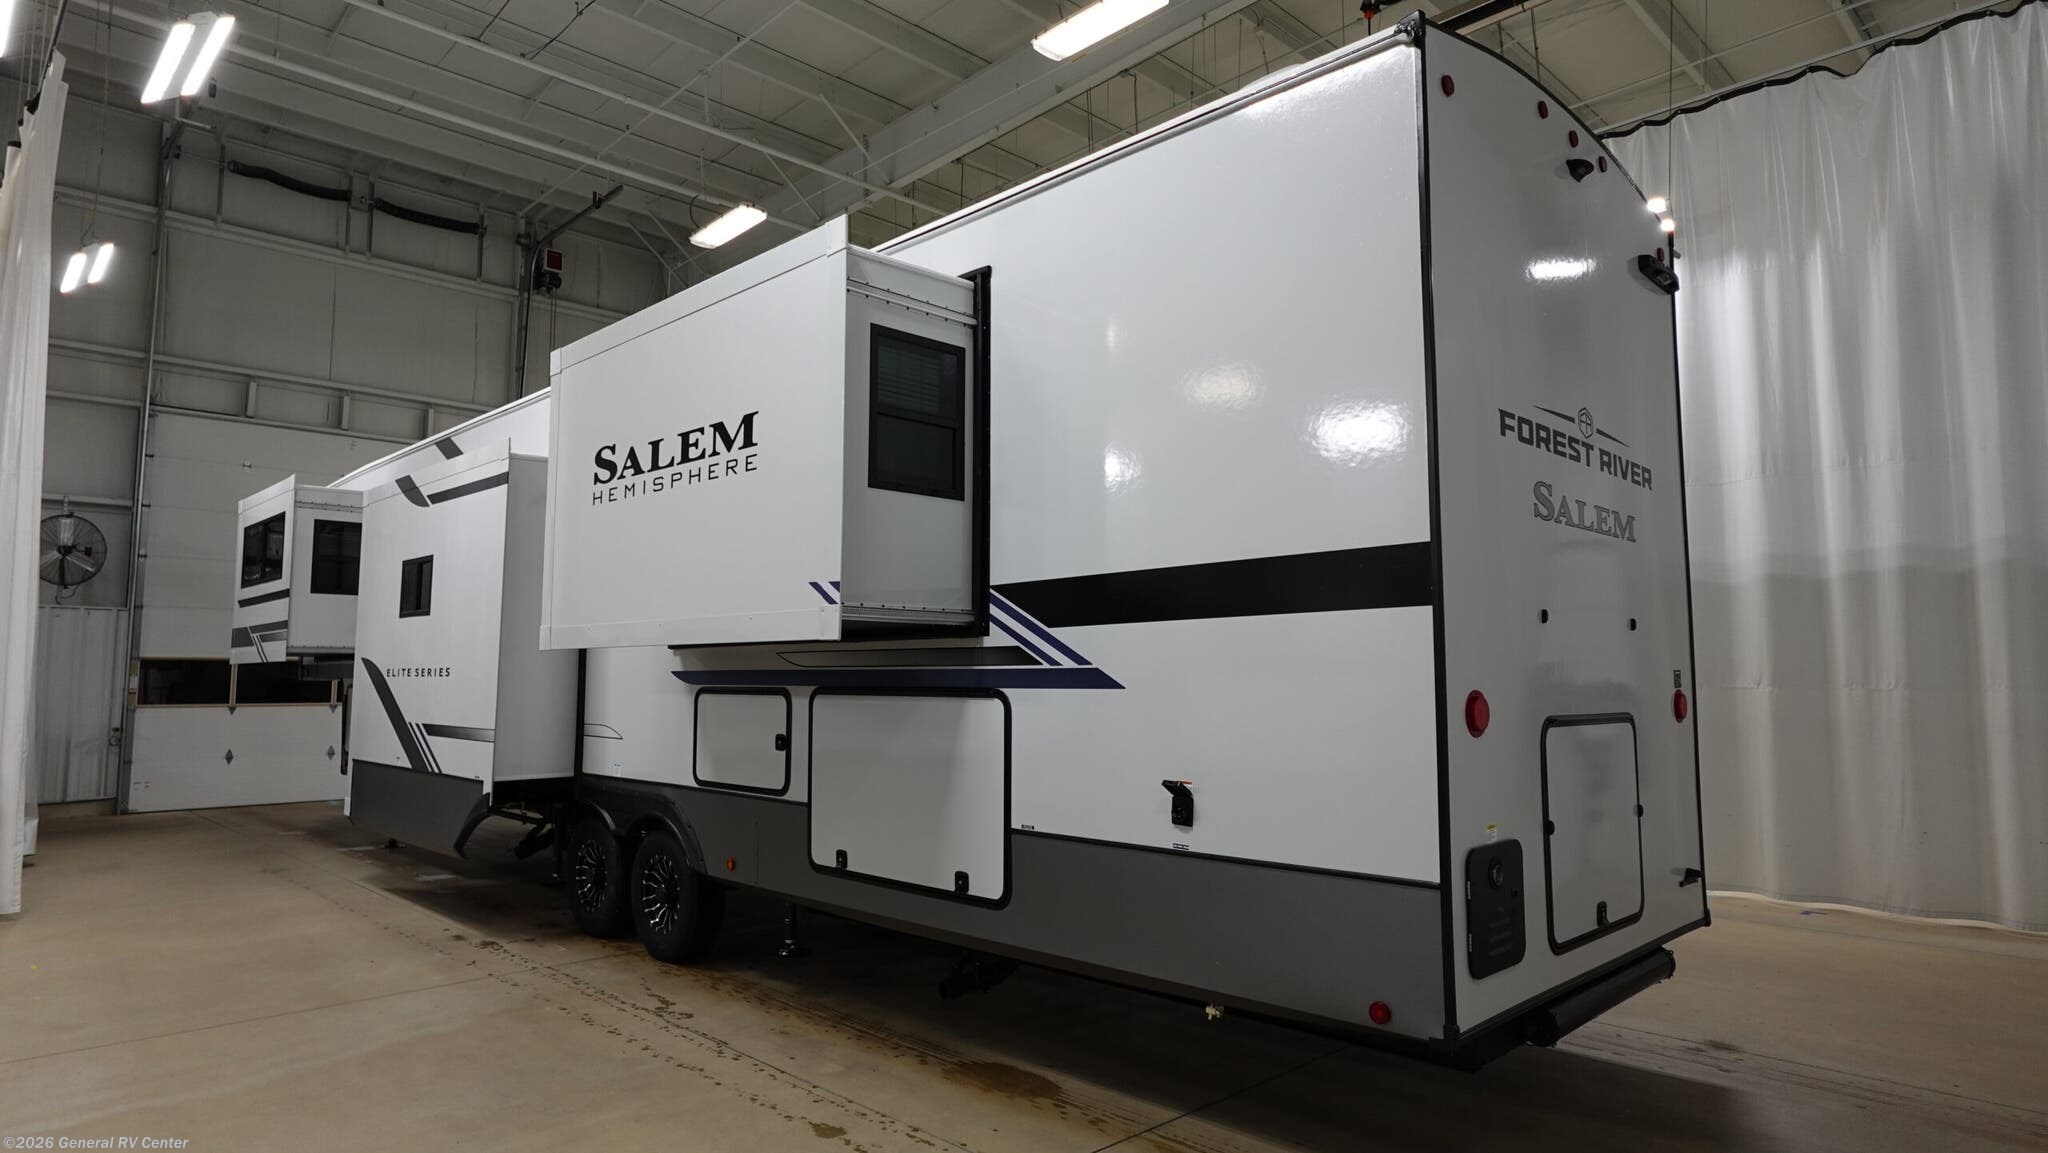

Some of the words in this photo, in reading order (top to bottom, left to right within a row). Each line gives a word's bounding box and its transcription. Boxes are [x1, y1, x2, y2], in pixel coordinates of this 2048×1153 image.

[592, 453, 758, 506] HEMISPHERE
[593, 411, 759, 485] SALEM
[1498, 408, 1595, 467] FOREST
[1598, 447, 1653, 491] RIVER
[1533, 480, 1637, 543] SALEM
[386, 668, 412, 678] ELITE
[414, 667, 451, 678] SERIES
